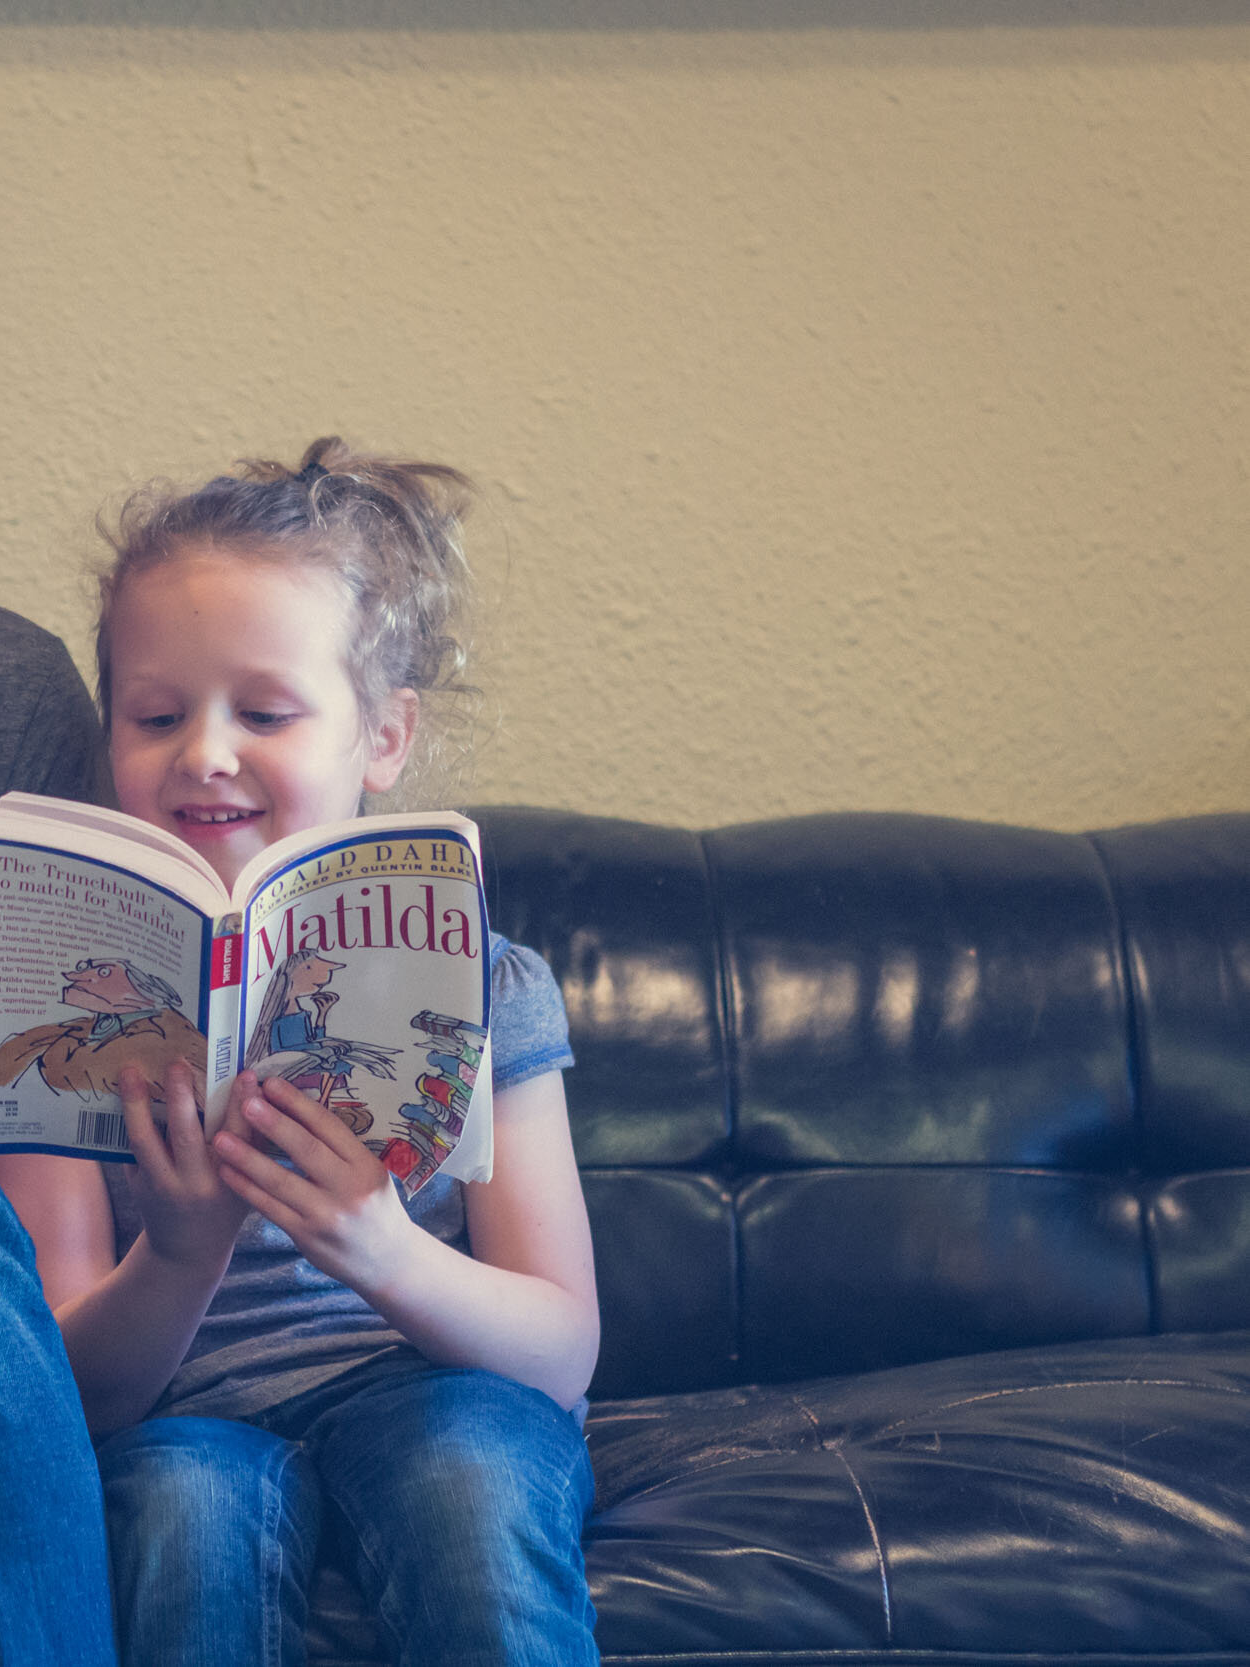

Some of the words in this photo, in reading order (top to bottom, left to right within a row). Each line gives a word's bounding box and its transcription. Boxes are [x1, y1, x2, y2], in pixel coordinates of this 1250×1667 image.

[255, 851, 356, 914] ROALD
[376, 843, 470, 868] DAHL
[336, 868, 352, 878] BY
[360, 863, 422, 874] QUENTIN
[430, 864, 470, 877] BLAKE
[19, 879, 76, 901] match
[84, 888, 109, 908] for
[117, 900, 185, 943] Matilda!
[161, 904, 174, 921] is
[224, 939, 232, 963] ROALD
[252, 884, 478, 984] Matilda
[223, 964, 231, 984] DAHL
[215, 1035, 232, 1082] MATILDA
